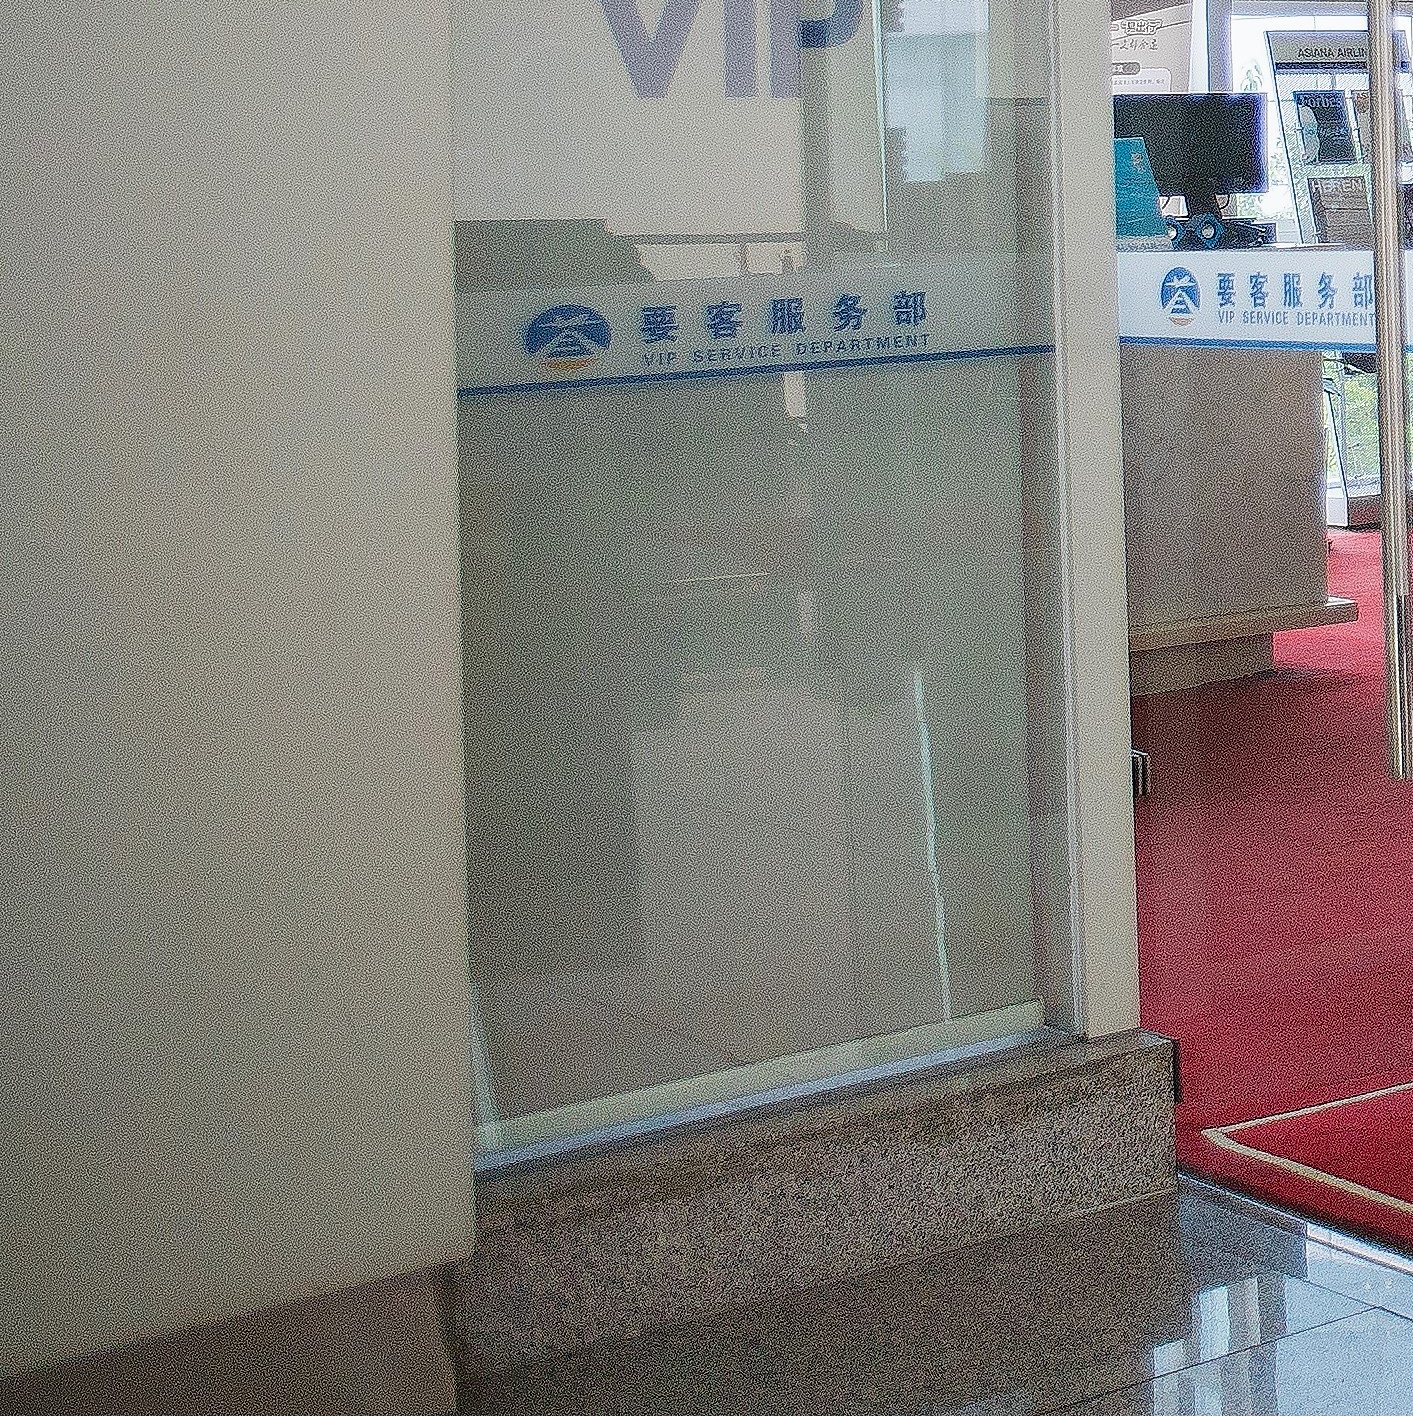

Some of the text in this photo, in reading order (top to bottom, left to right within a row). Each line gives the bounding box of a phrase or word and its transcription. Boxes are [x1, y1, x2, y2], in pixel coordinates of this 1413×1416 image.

[1297, 47, 1368, 58] ASIANA AIRLIN
[1217, 271, 1374, 310] 要客服务部
[641, 290, 928, 344] 要客服务部
[1217, 310, 1376, 326] VIP SERVICE DEPARTMENT
[642, 333, 932, 367] VIP SERVICE DEPARTMENT
